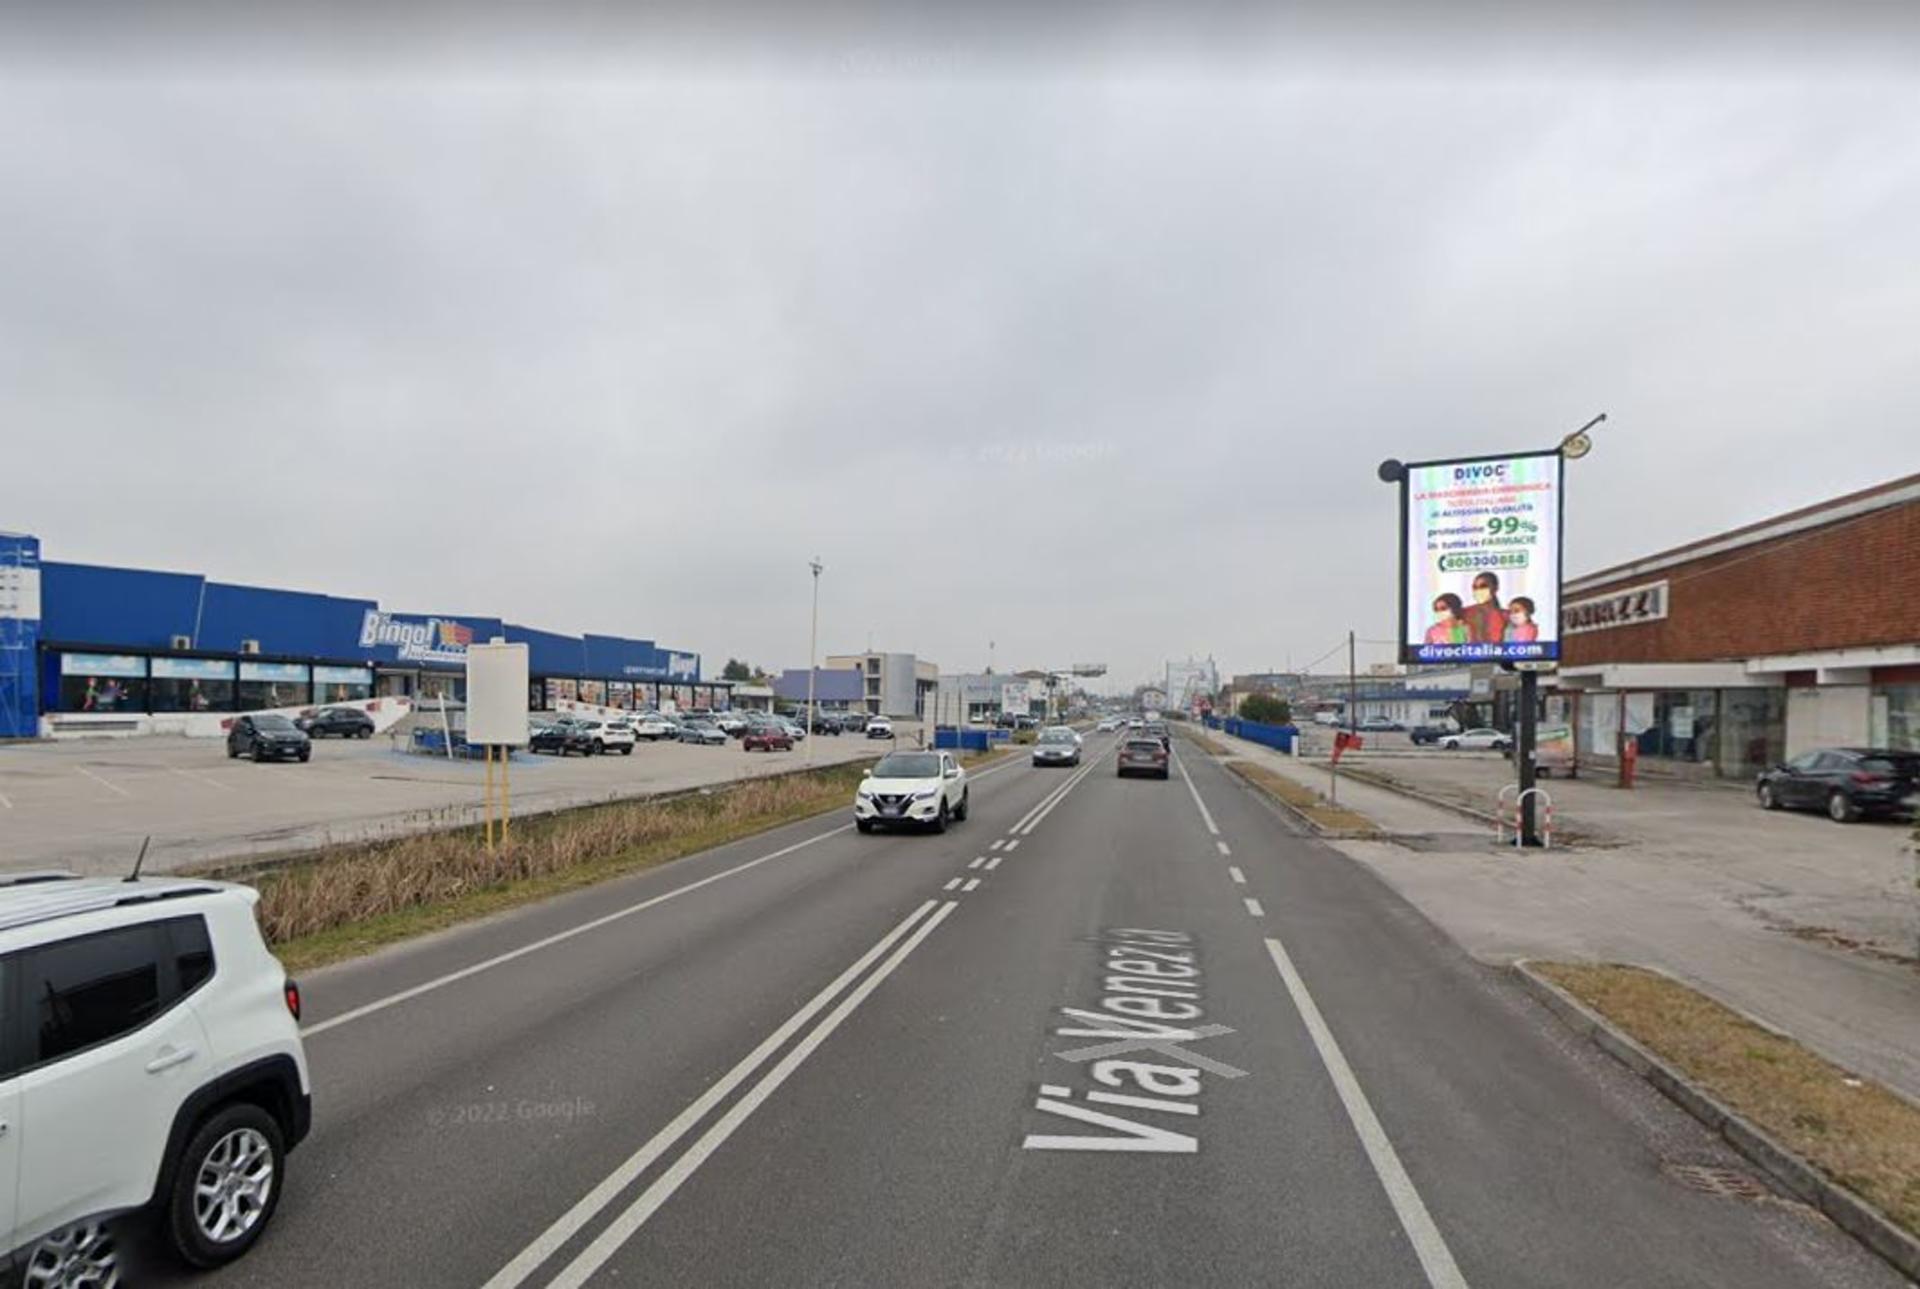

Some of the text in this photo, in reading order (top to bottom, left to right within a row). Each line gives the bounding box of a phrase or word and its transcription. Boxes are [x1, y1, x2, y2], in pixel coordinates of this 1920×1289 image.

[1455, 464, 1506, 480] DIVOC
[1427, 515, 1538, 538] protezione 99%
[1427, 541, 1438, 550] in
[1470, 538, 1480, 548] le
[1481, 535, 1537, 548] FARMACIE
[1418, 643, 1543, 658] divocitalia.com
